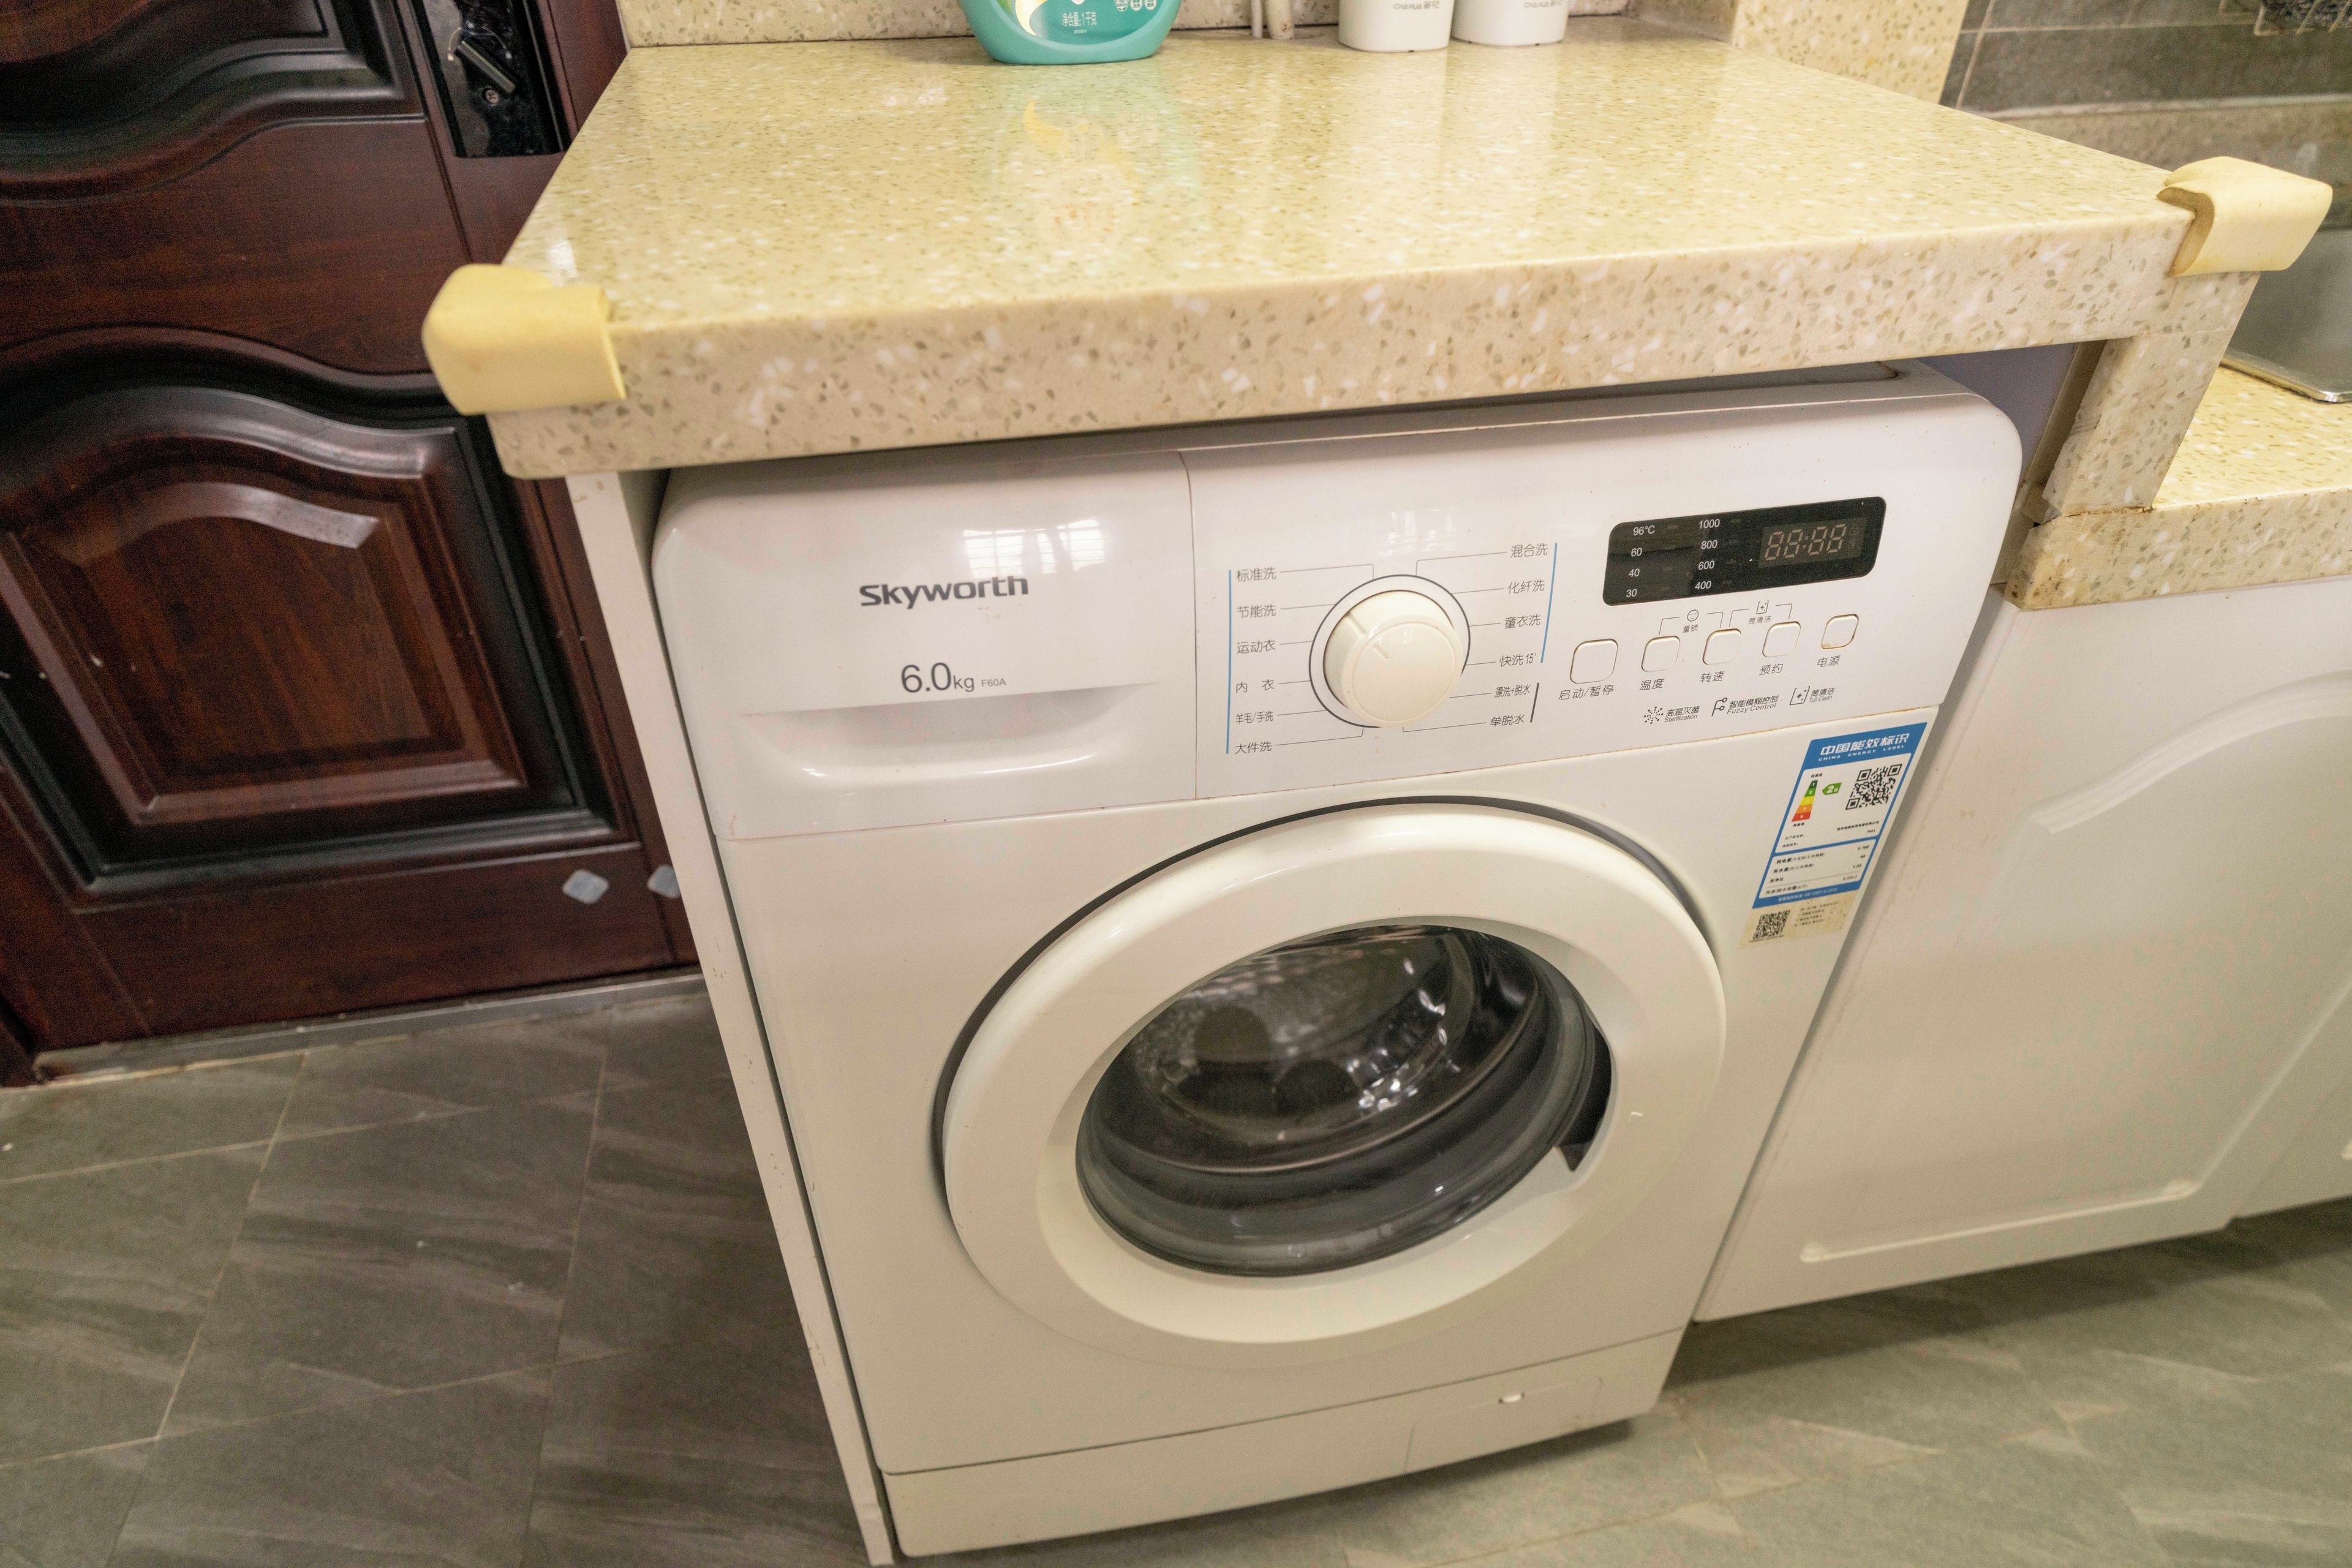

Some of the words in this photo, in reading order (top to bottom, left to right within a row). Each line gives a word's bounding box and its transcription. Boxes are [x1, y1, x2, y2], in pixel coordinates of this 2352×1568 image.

[1698, 518, 1721, 529] 1000
[1633, 524, 1656, 537] 96°C
[1510, 543, 1548, 559] 混合洗
[1701, 540, 1718, 550] 800
[1630, 547, 1643, 557] 60
[1698, 560, 1715, 570] 600
[1236, 567, 1276, 582] 标准洗
[1629, 568, 1640, 578] 40
[859, 575, 1030, 609] Skyworth
[1507, 579, 1545, 594] 化纤洗
[1694, 580, 1712, 591] 400
[1626, 589, 1637, 598] 30
[1237, 604, 1276, 619] 节能洗
[1504, 614, 1541, 630] 童衣洗
[1748, 615, 1771, 625] 筒清洁
[1683, 624, 1698, 633] 童锁
[1236, 640, 1276, 655] 运动衣
[1817, 655, 1841, 668] 电源
[1759, 663, 1783, 676] 预约
[981, 677, 1007, 688] F60A
[1700, 671, 1724, 684] 转速
[1494, 684, 1531, 698] 漂洗+脱水
[1640, 678, 1664, 691] 温度
[1558, 684, 1615, 701] 启动/暂停
[1809, 687, 1835, 698] 筒清洁
[1727, 694, 1779, 710] 智能模糊控制
[1727, 704, 1750, 715] Fuzzy
[1752, 701, 1777, 712] Control
[1235, 710, 1274, 724] 羊毛/手洗
[1664, 712, 1699, 723] Sterilization
[1665, 705, 1700, 718] 高温灭菌
[1490, 714, 1525, 727] 单脱水
[1235, 741, 1272, 755] 大件洗
[1820, 733, 1910, 755] 中国能效标识
